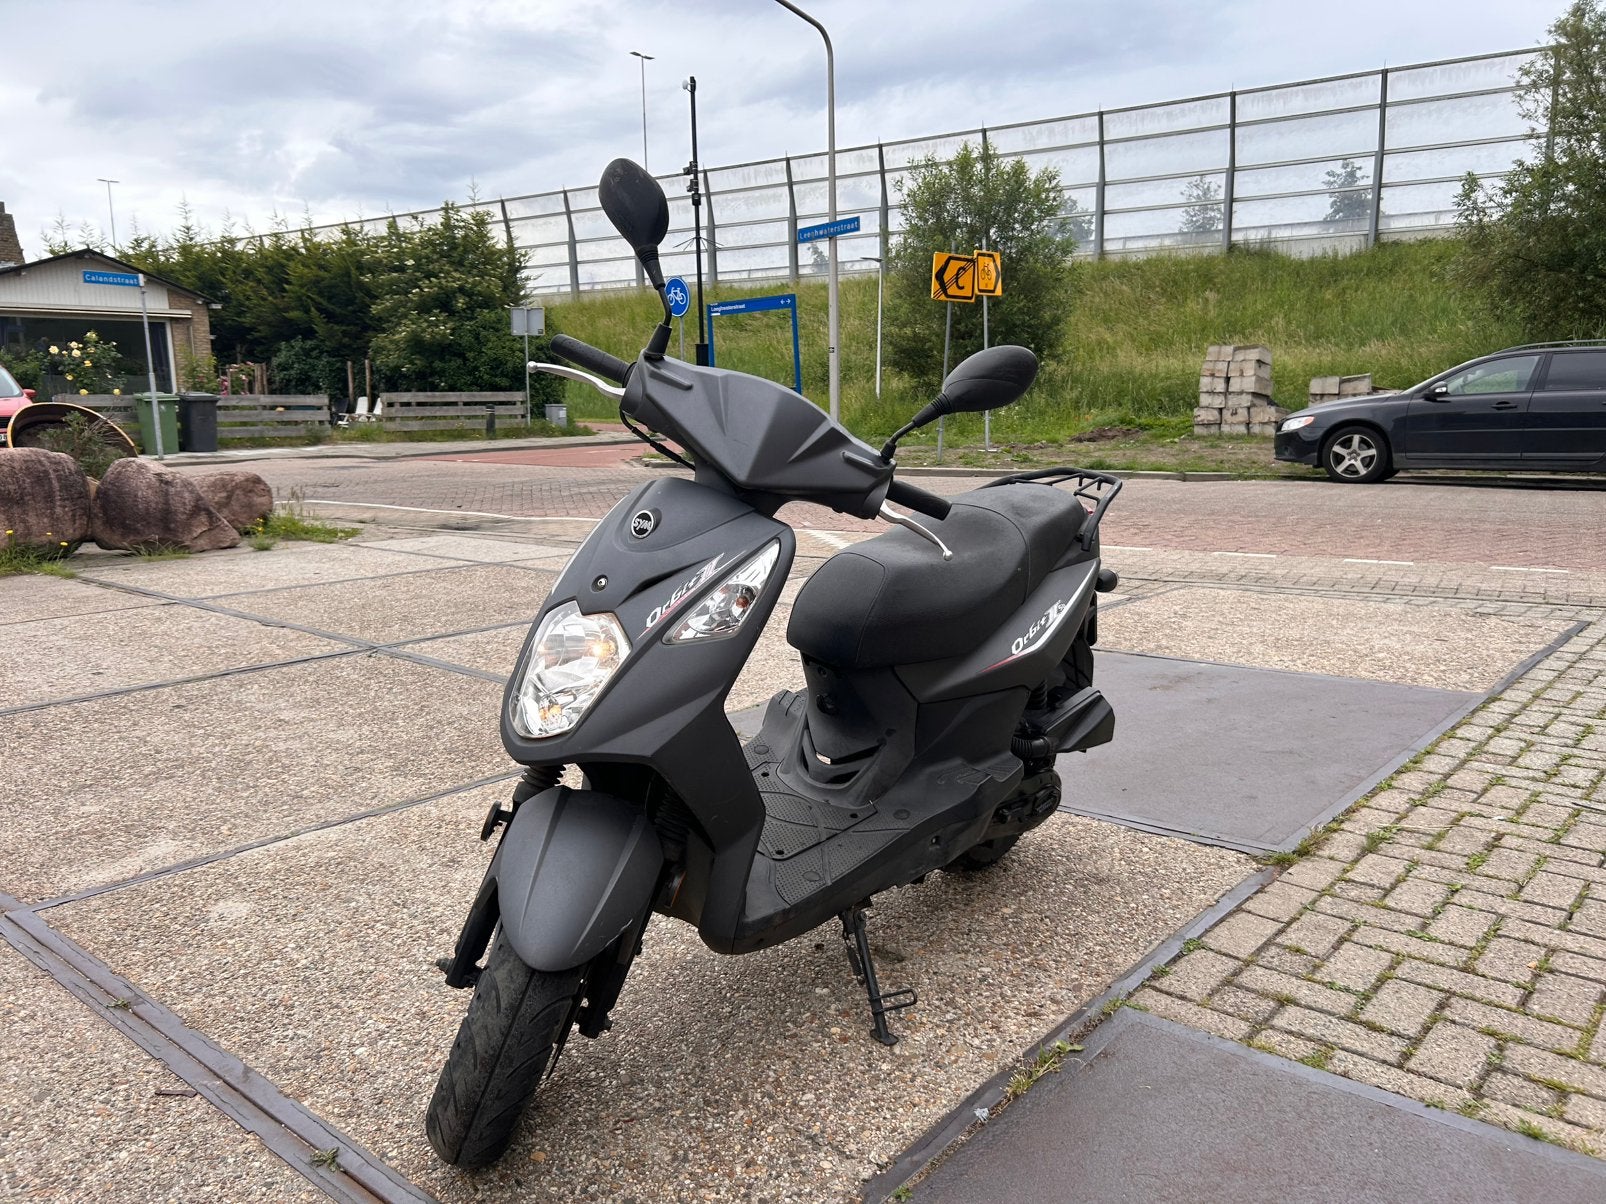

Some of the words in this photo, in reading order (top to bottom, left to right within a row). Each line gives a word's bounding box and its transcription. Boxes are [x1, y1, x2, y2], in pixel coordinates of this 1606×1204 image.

[85, 274, 138, 285] Calandstraat
[633, 517, 652, 531] SYM
[1011, 614, 1047, 655] Orbit
